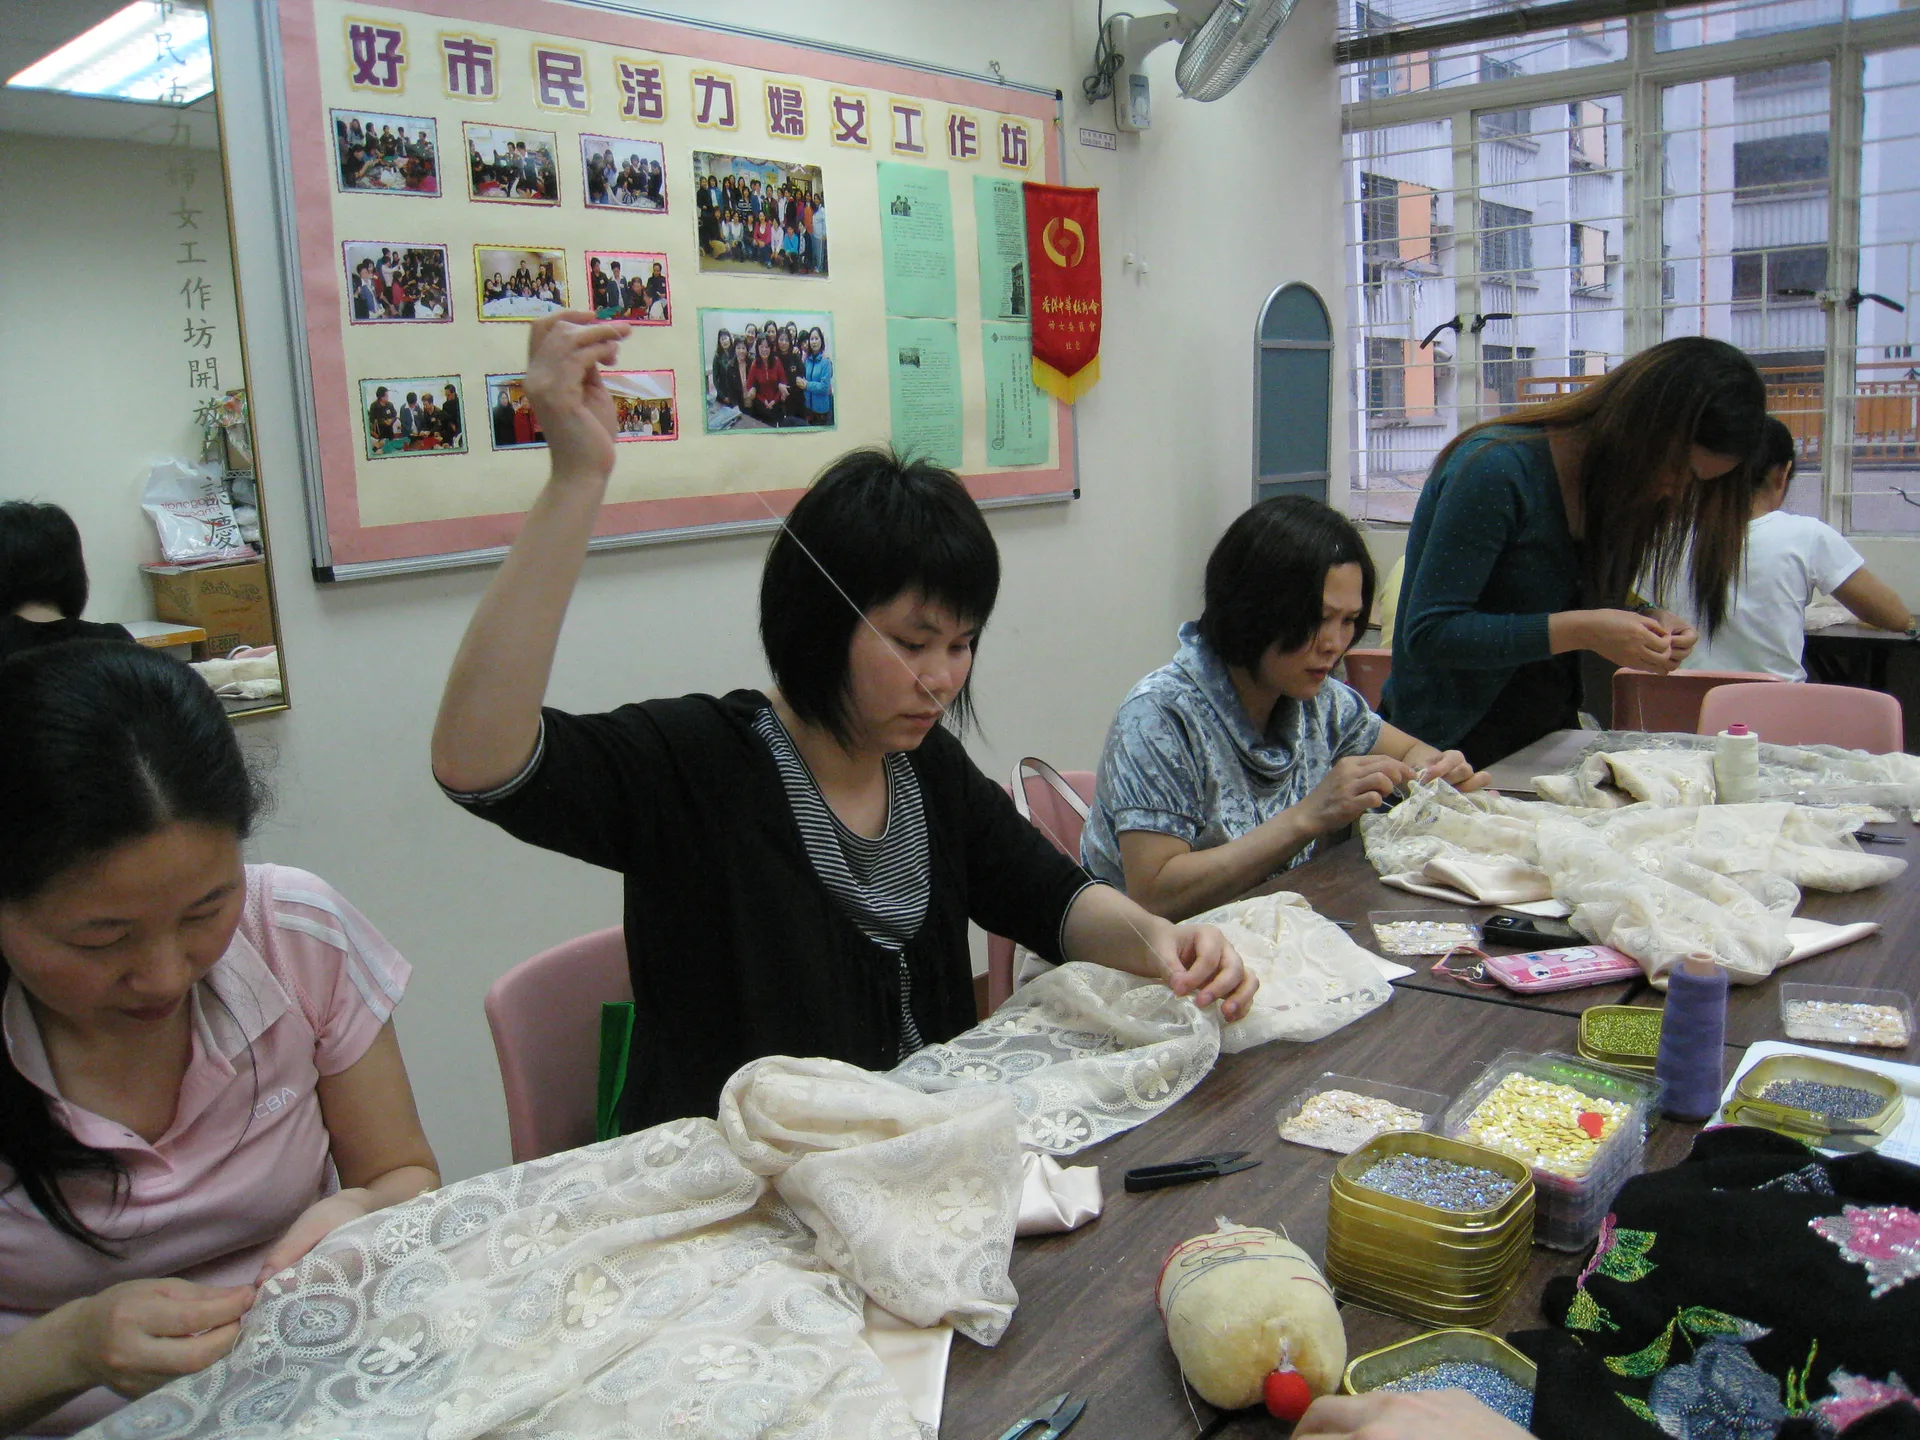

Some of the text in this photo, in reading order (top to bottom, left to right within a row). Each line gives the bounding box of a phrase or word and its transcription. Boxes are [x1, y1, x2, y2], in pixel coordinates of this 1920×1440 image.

[350, 24, 1027, 167] 好市民活力婦女工作坊
